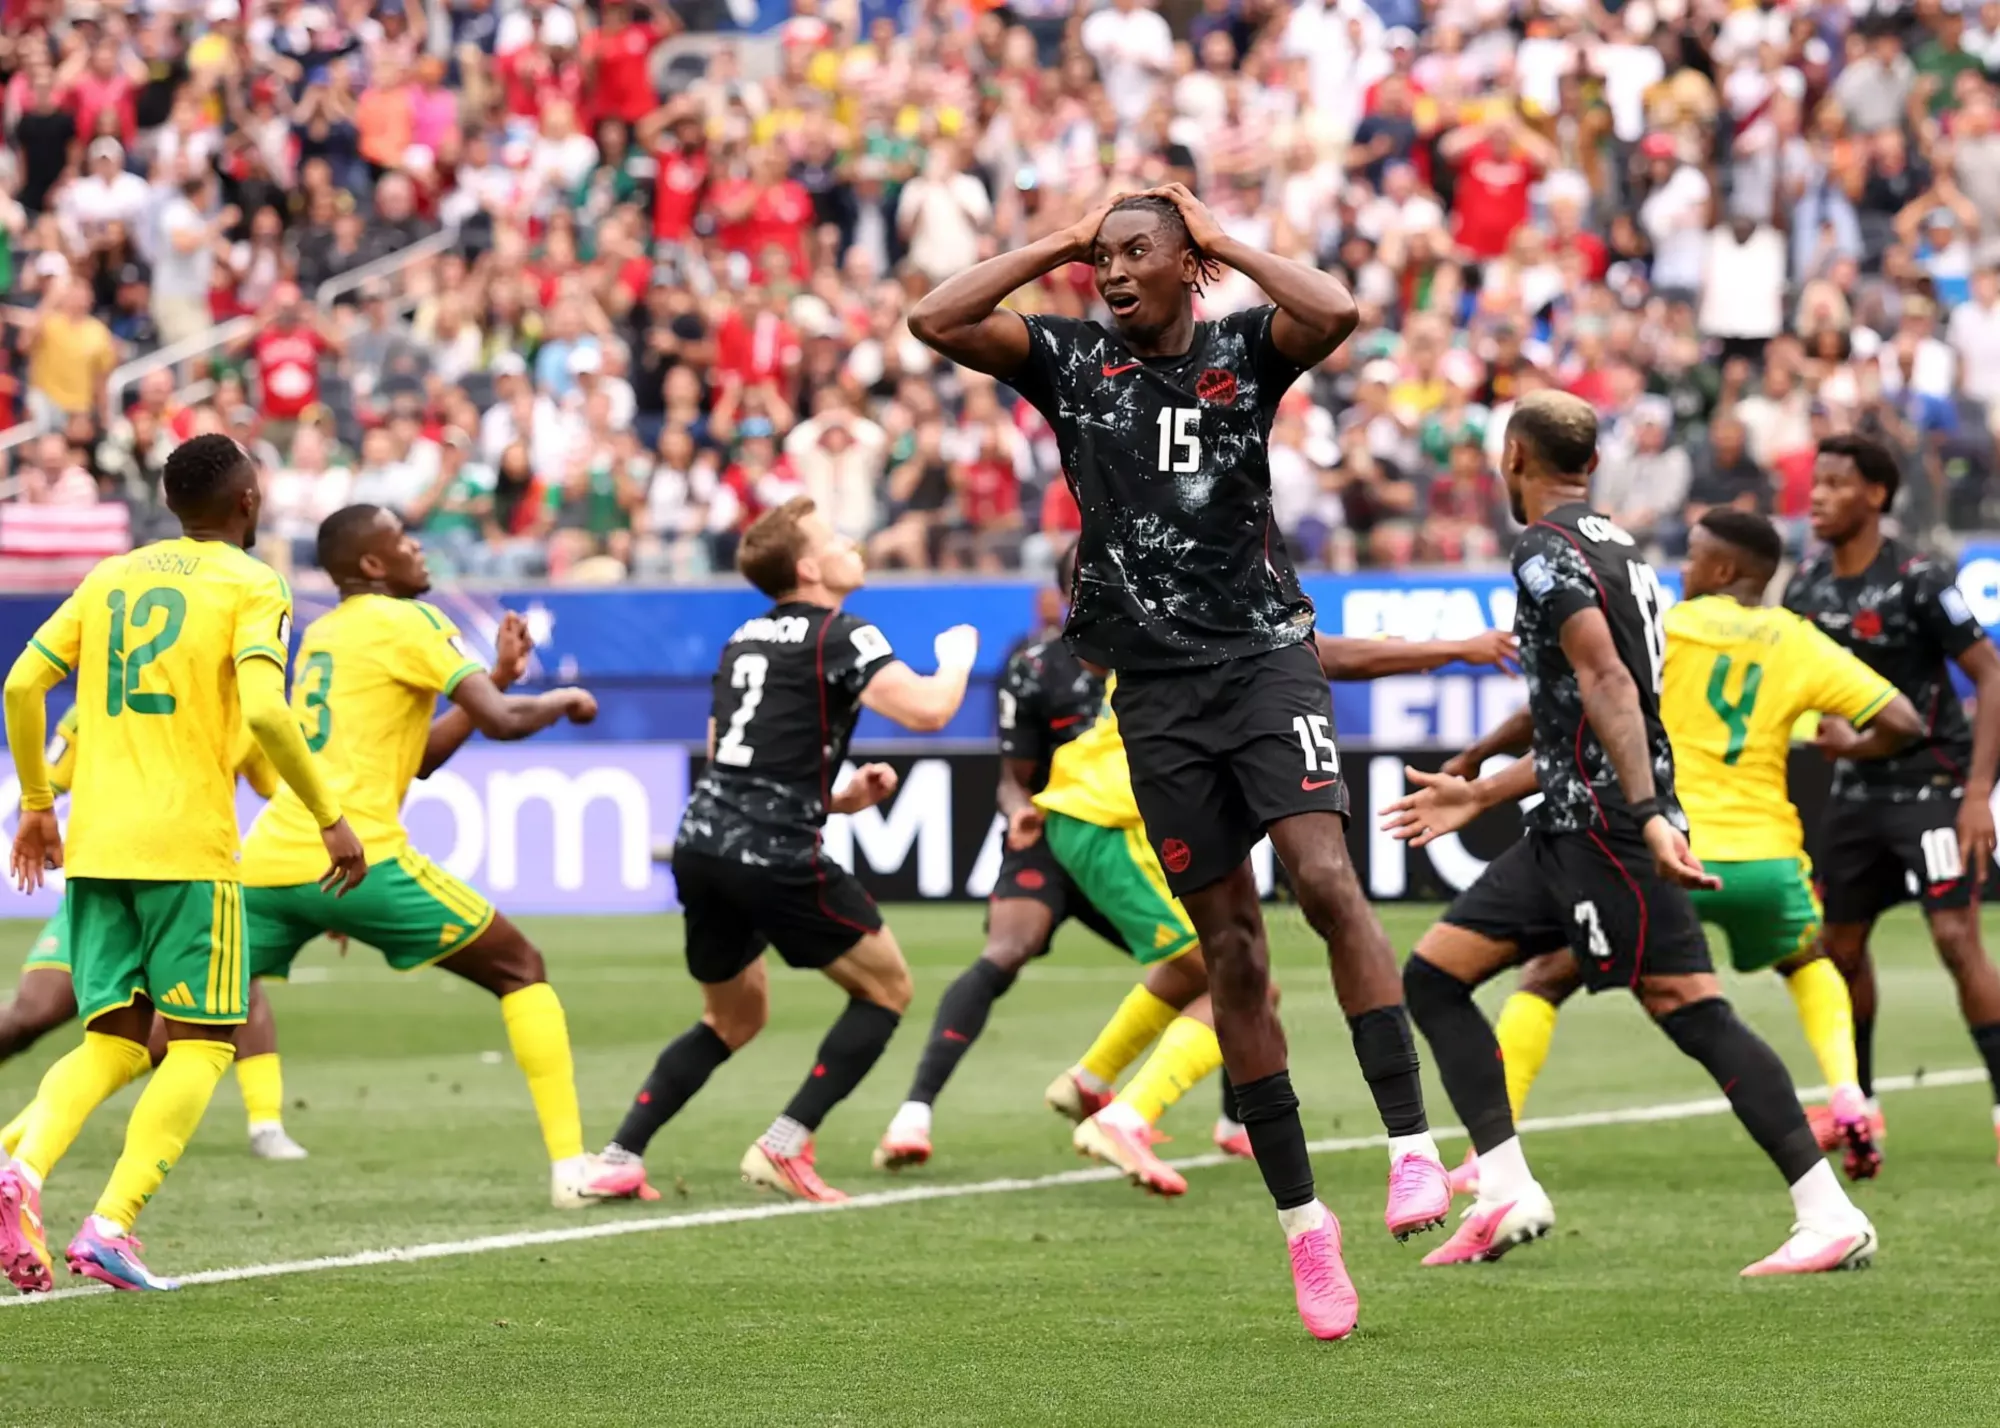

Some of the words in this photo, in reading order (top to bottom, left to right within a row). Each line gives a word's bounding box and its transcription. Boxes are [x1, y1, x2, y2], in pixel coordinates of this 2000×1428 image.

[1200, 377, 1234, 398] CANADA
[1156, 406, 1202, 473] 15
[106, 585, 187, 717] 12
[715, 652, 770, 768] 2
[1706, 652, 1762, 765] 4
[1292, 714, 1340, 774] 15
[1920, 826, 1965, 882] 10
